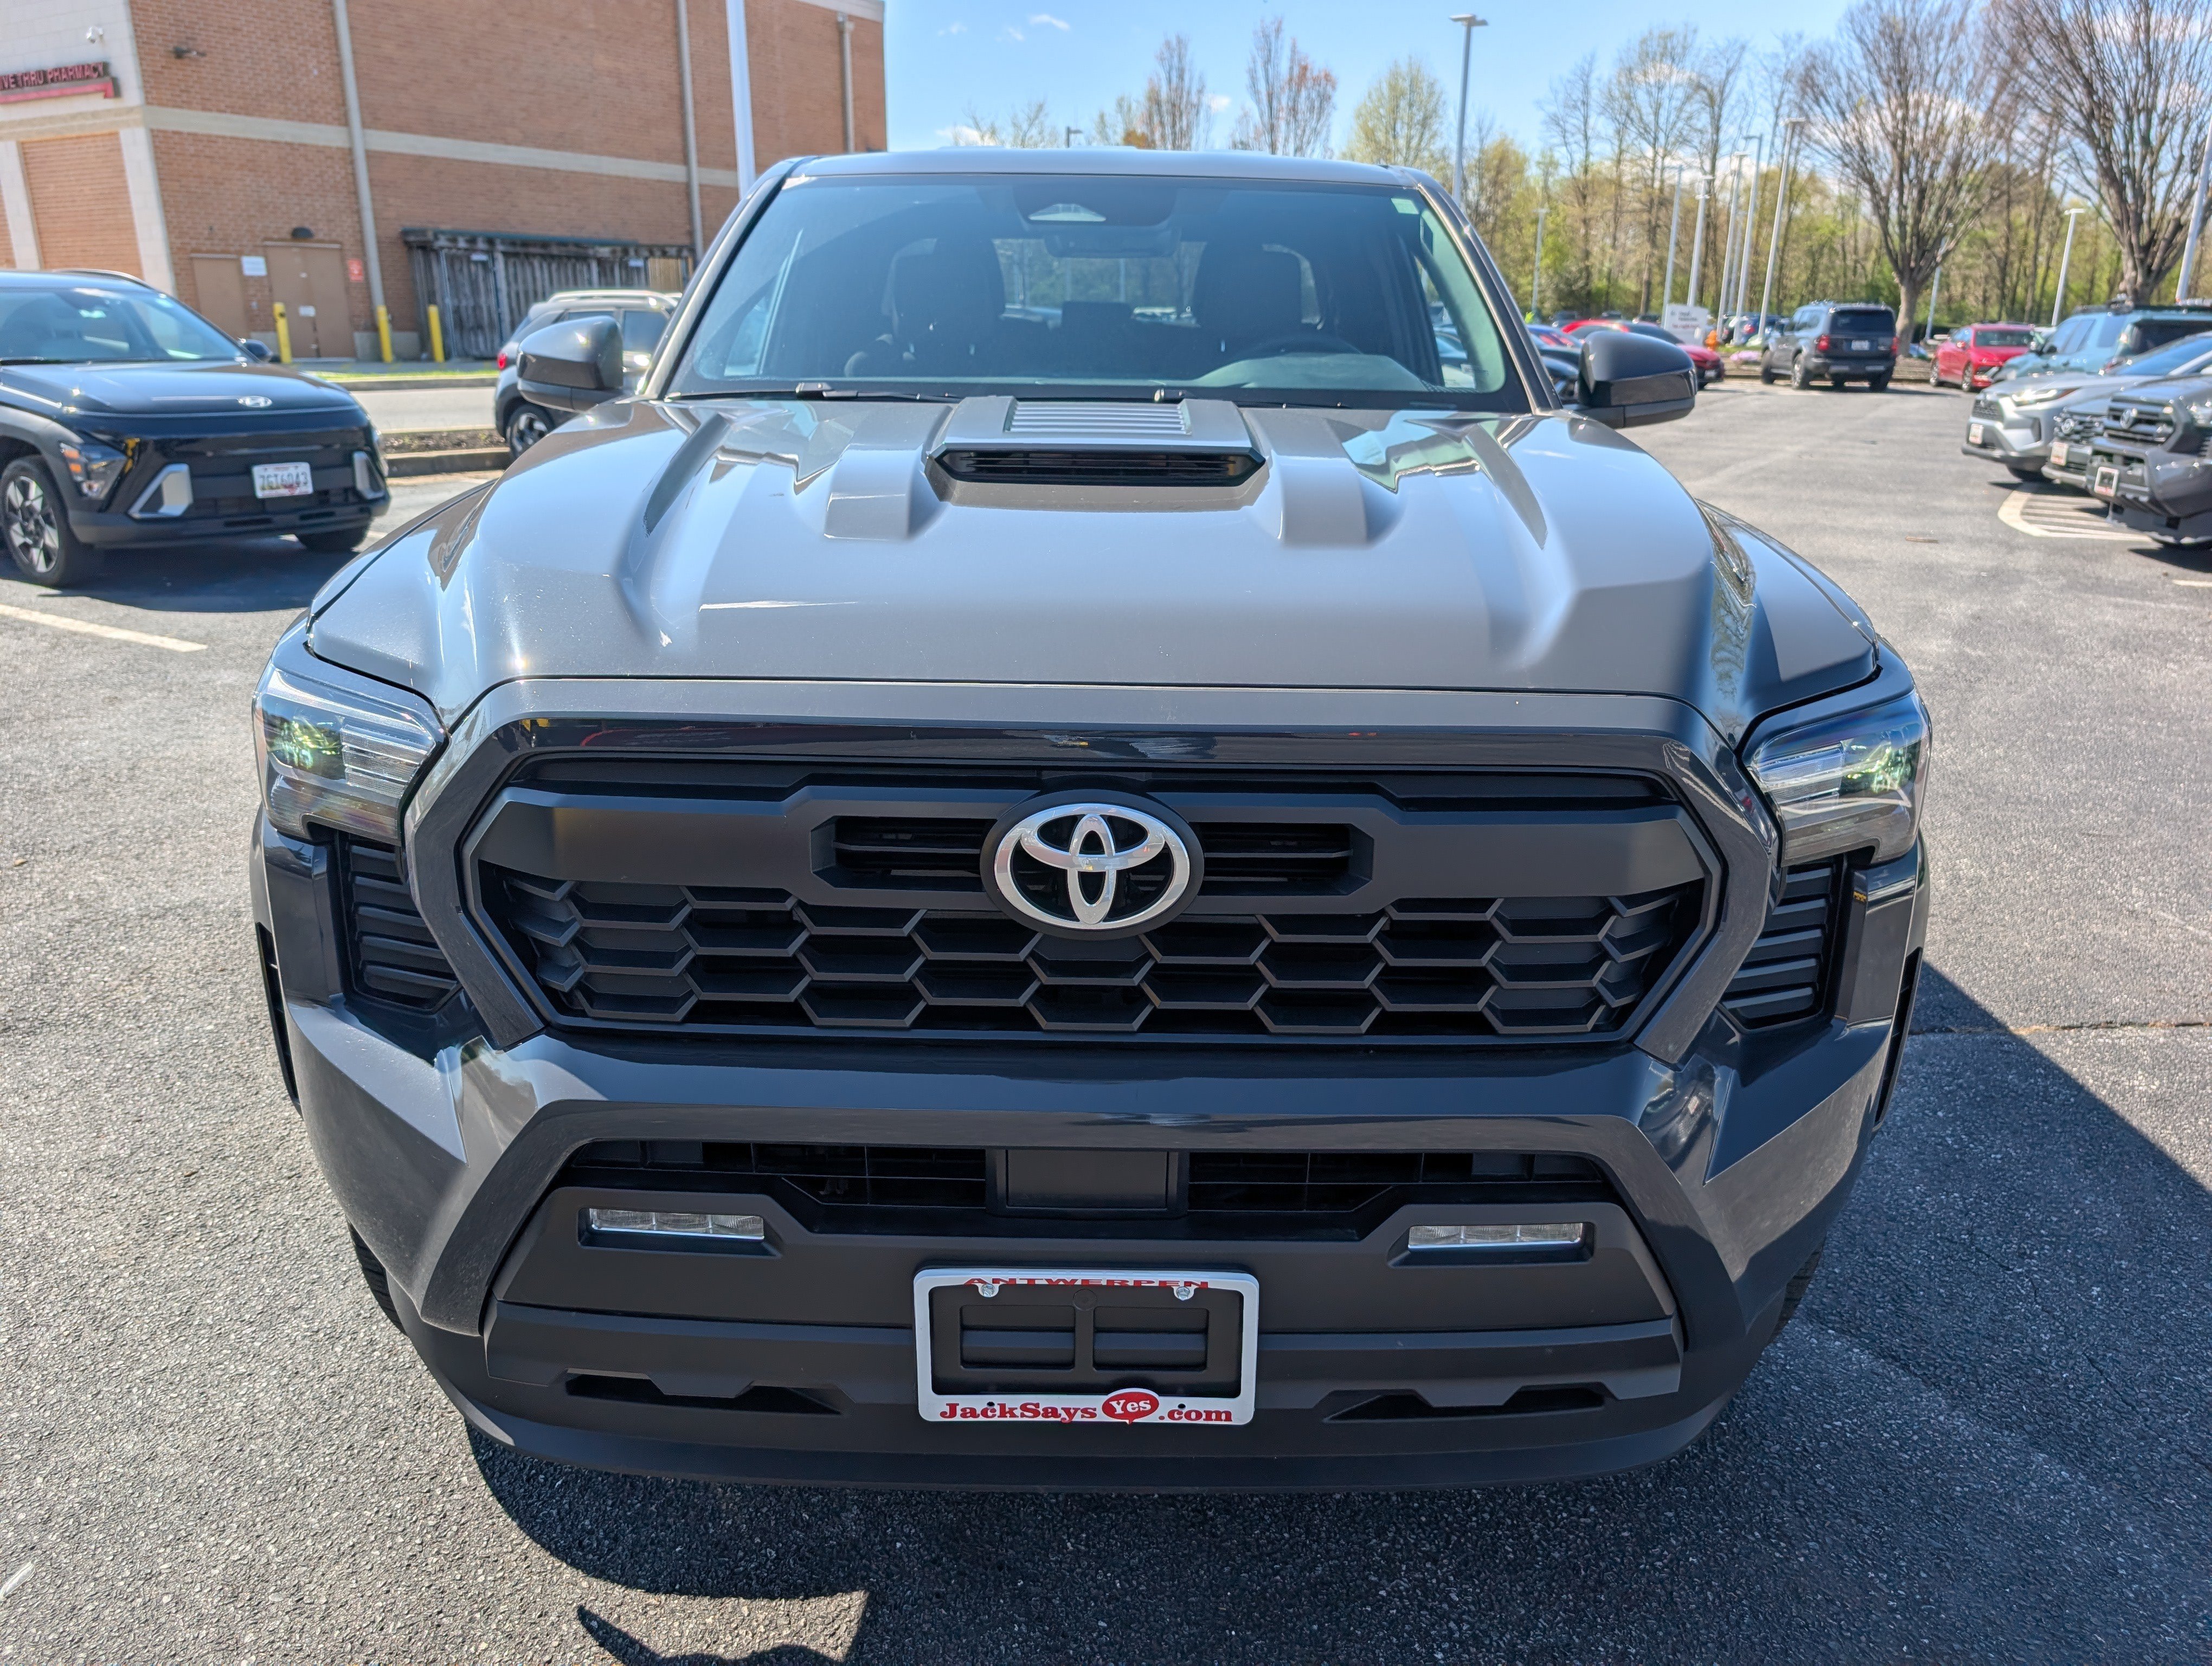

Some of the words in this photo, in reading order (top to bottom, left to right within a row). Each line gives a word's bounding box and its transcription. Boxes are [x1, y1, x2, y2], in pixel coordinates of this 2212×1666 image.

[17, 71, 43, 87] THRU
[47, 61, 104, 84] PHARMACY
[964, 1278, 1208, 1289] ANTWERPEN
[940, 1402, 1097, 1424] JackSays
[1109, 1400, 1152, 1414] Yes
[1159, 1409, 1233, 1422] .com
